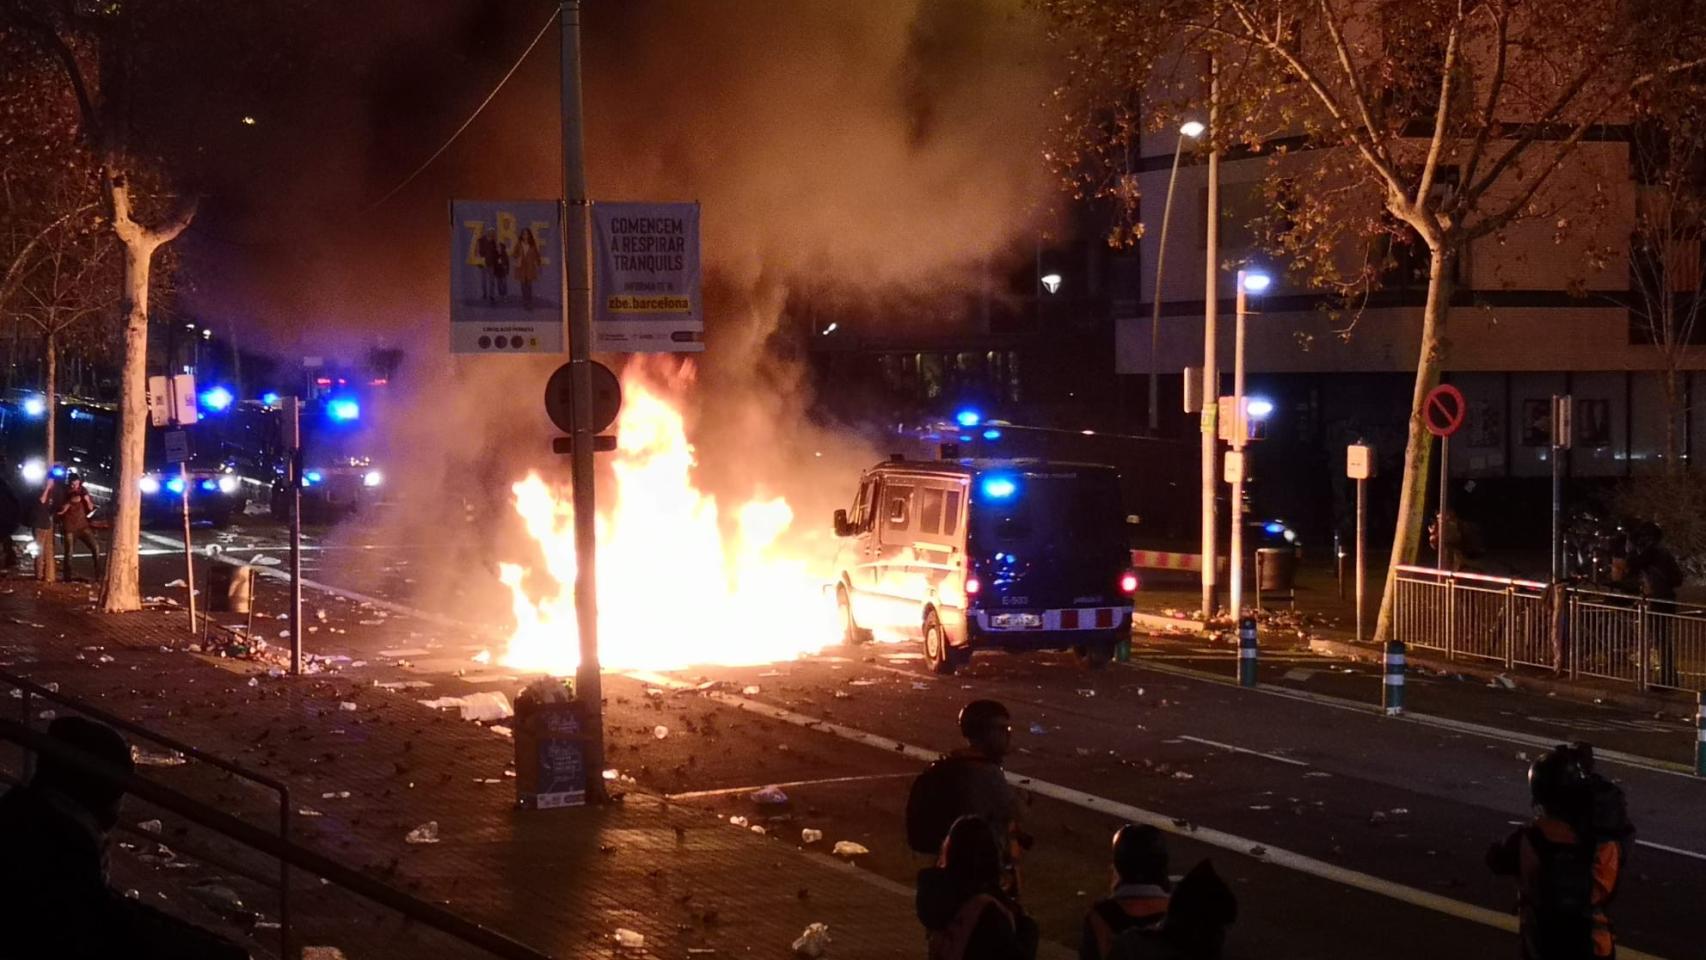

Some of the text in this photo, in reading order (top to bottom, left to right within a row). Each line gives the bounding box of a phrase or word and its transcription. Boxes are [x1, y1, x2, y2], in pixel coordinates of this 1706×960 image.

[611, 217, 682, 234] COMENCEM
[611, 235, 685, 253] A RESPIRAR
[614, 255, 684, 274] TRANQUILS
[608, 296, 689, 309] zbe.barcelona
